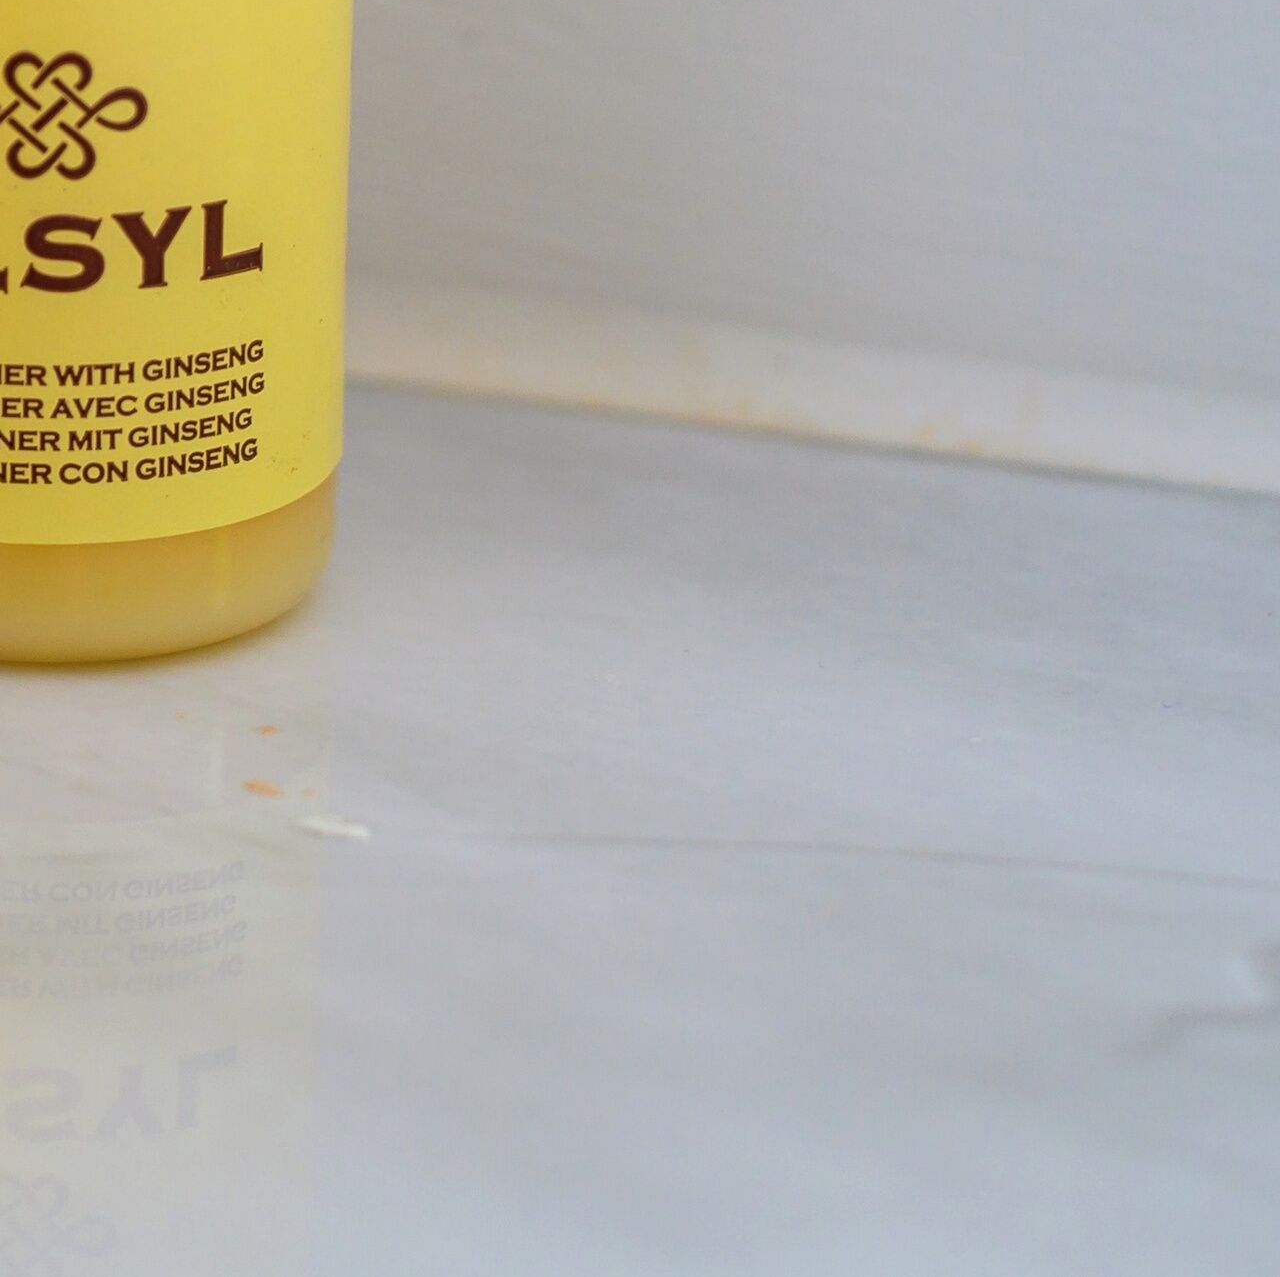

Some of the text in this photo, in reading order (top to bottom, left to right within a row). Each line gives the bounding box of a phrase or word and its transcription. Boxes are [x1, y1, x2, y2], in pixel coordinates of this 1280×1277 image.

[52, 361, 135, 387] WITH
[142, 339, 264, 382] GINSENG
[50, 394, 138, 419] AVEC
[144, 371, 265, 414] GINSENG
[68, 427, 123, 452] MIT
[127, 407, 253, 448] GINSENG
[58, 459, 129, 485] CON
[135, 437, 258, 481] GINSENG
